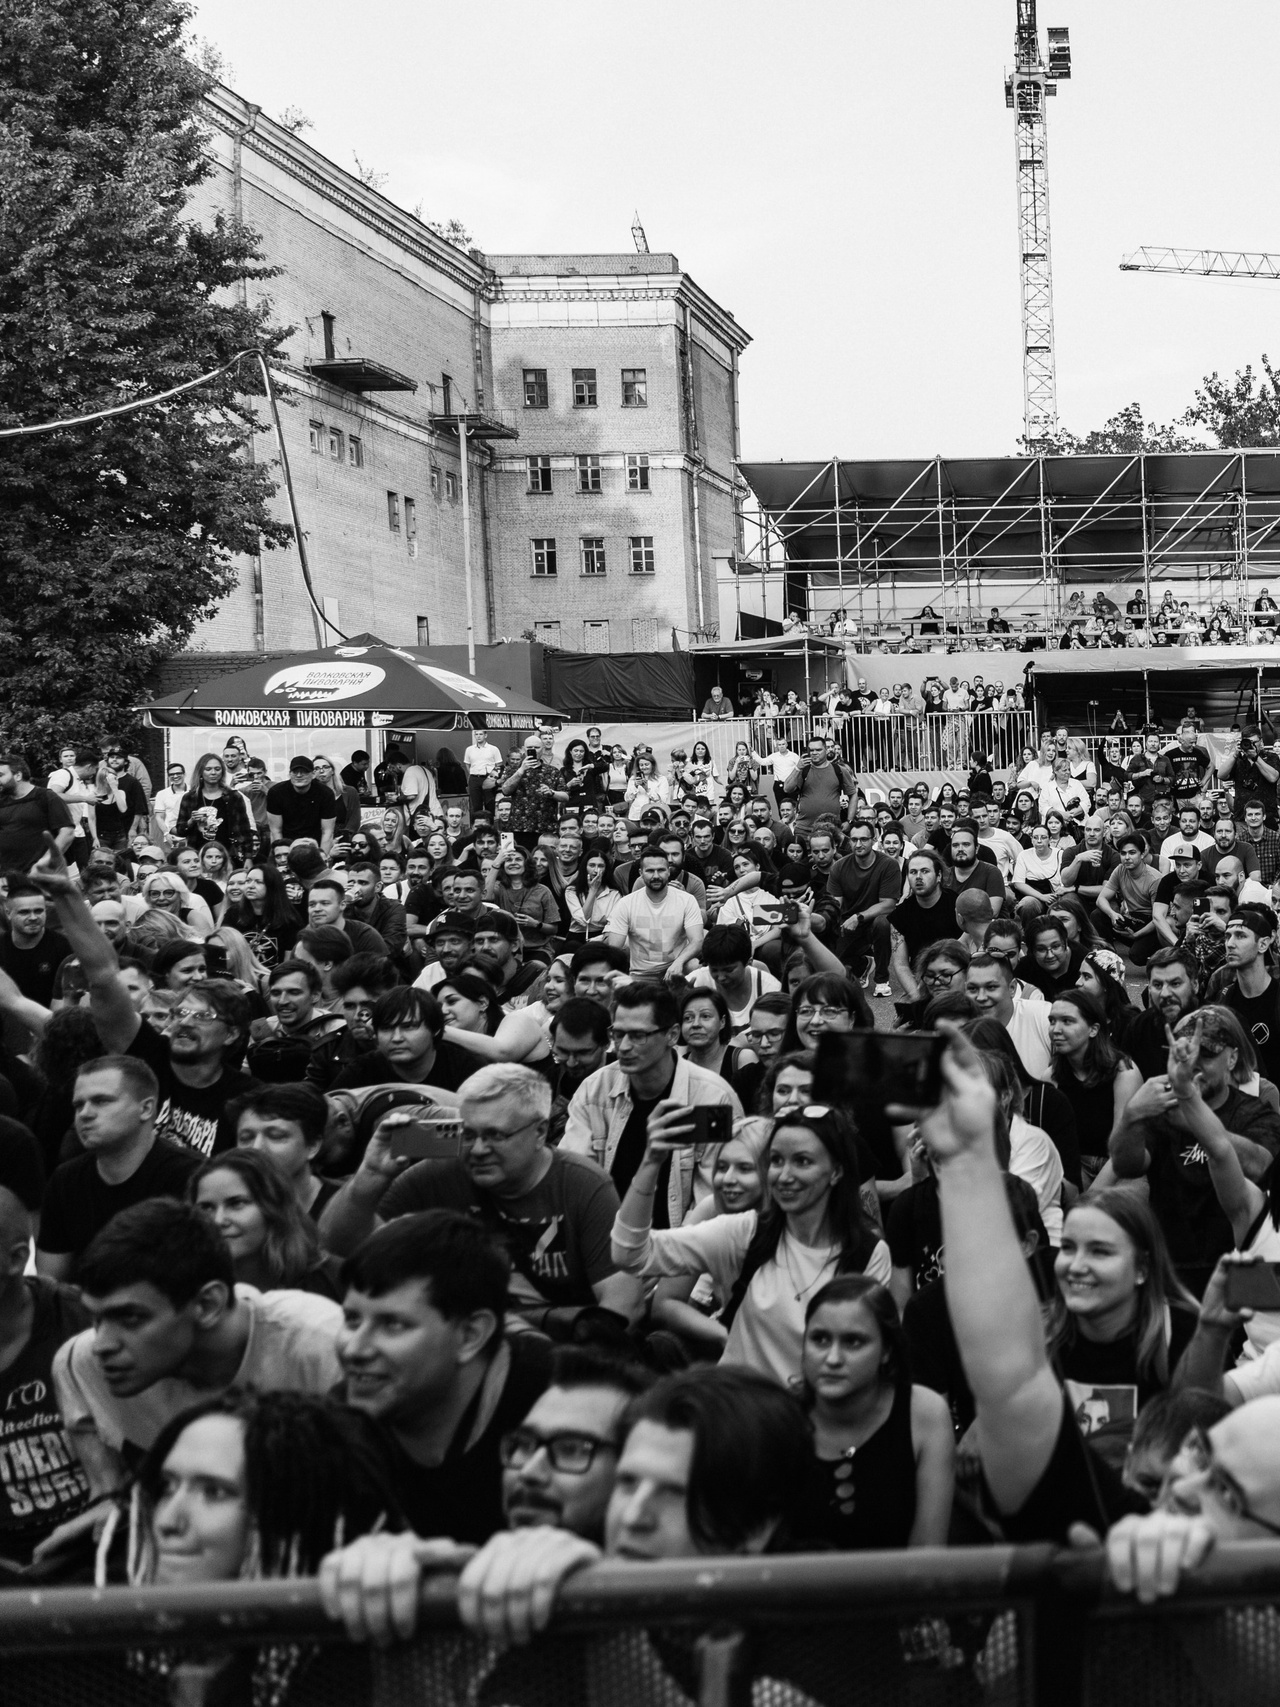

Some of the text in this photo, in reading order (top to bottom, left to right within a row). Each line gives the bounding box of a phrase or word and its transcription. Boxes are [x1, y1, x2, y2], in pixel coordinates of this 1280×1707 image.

[306, 671, 372, 679] ВОЛКОВСКАЯ
[302, 678, 365, 686] ПИВОВАРНЯ
[215, 710, 365, 727] ВОЛКОВСКАЯ ПИВОВАРНЯ
